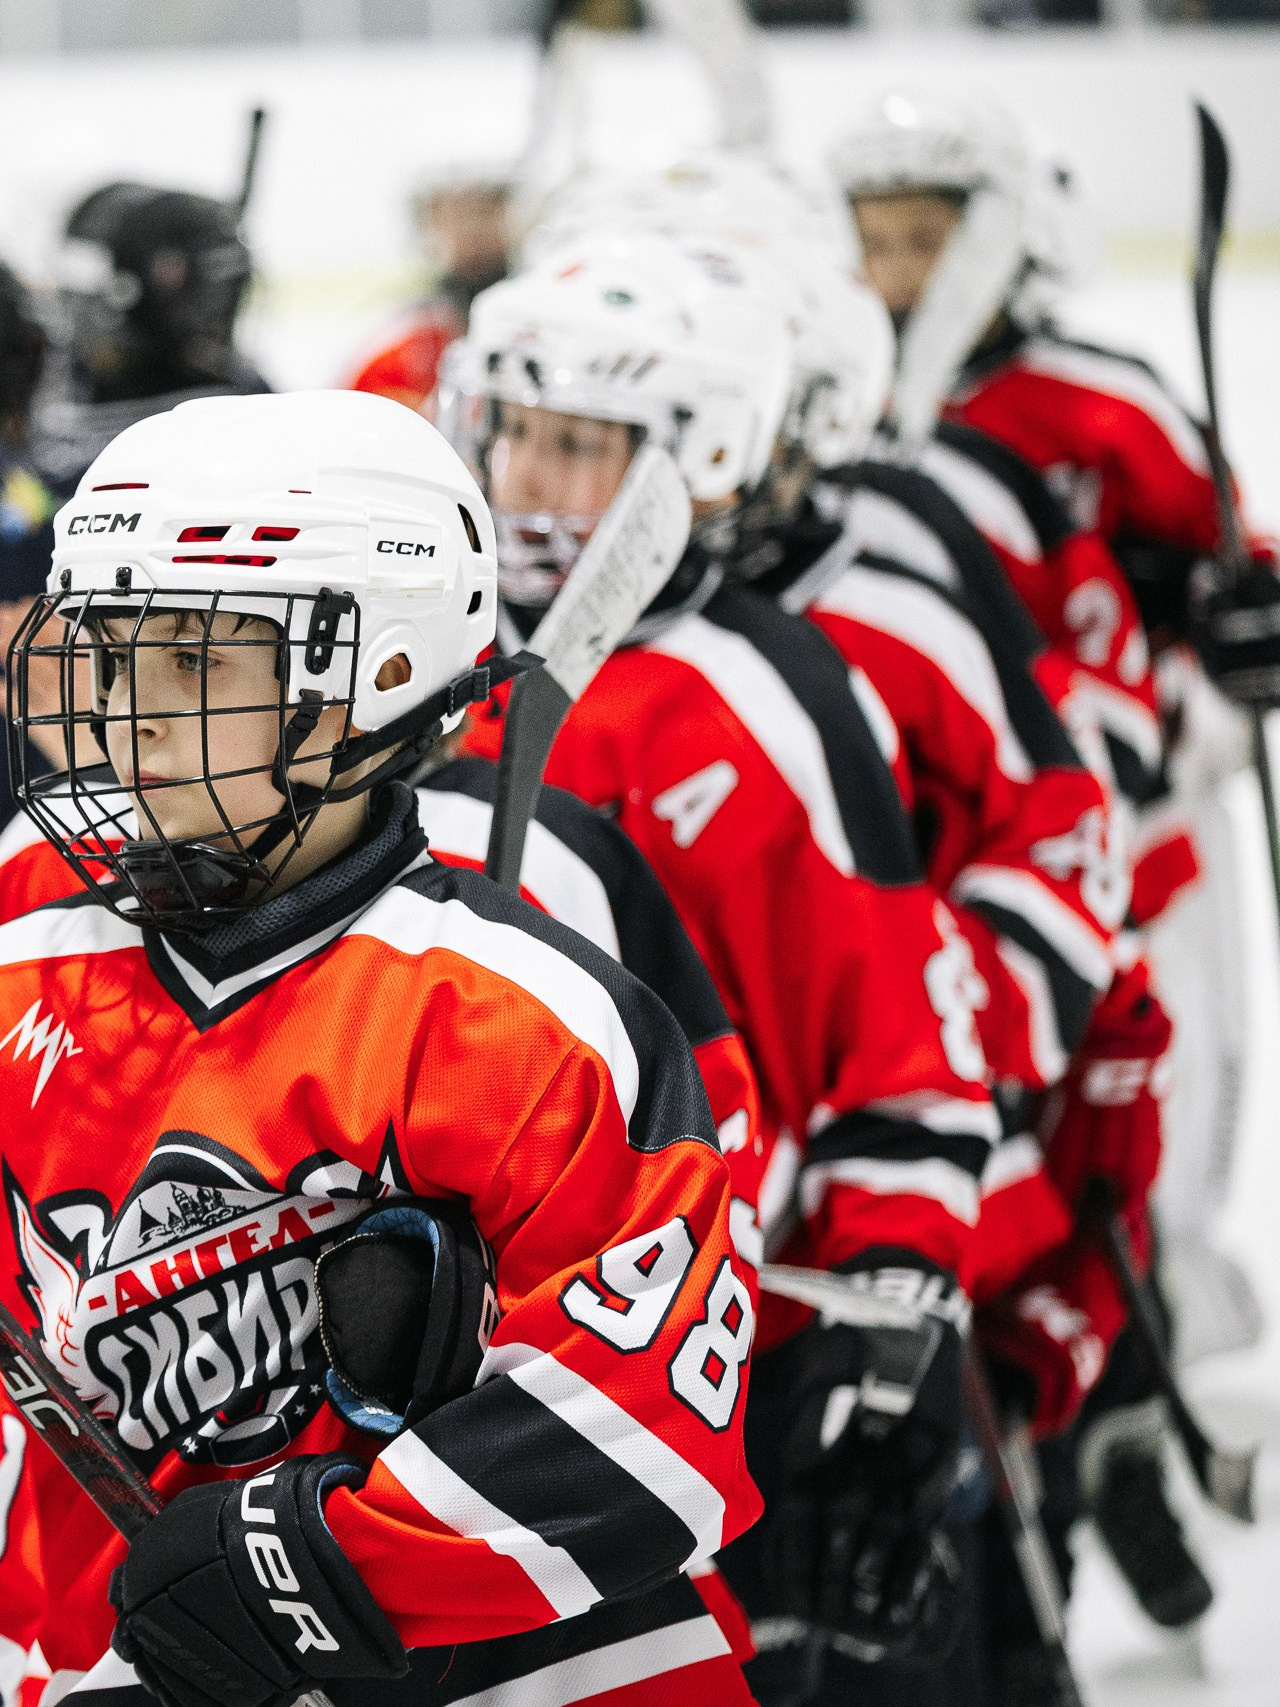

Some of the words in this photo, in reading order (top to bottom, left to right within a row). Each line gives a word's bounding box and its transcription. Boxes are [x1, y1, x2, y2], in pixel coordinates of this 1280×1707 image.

[67, 512, 142, 536] CCM
[376, 540, 436, 558] CCM
[652, 758, 740, 850] A
[97, 1256, 322, 1451] СИБИР
[558, 1214, 754, 1434] 98
[220, 1460, 341, 1654] UER
